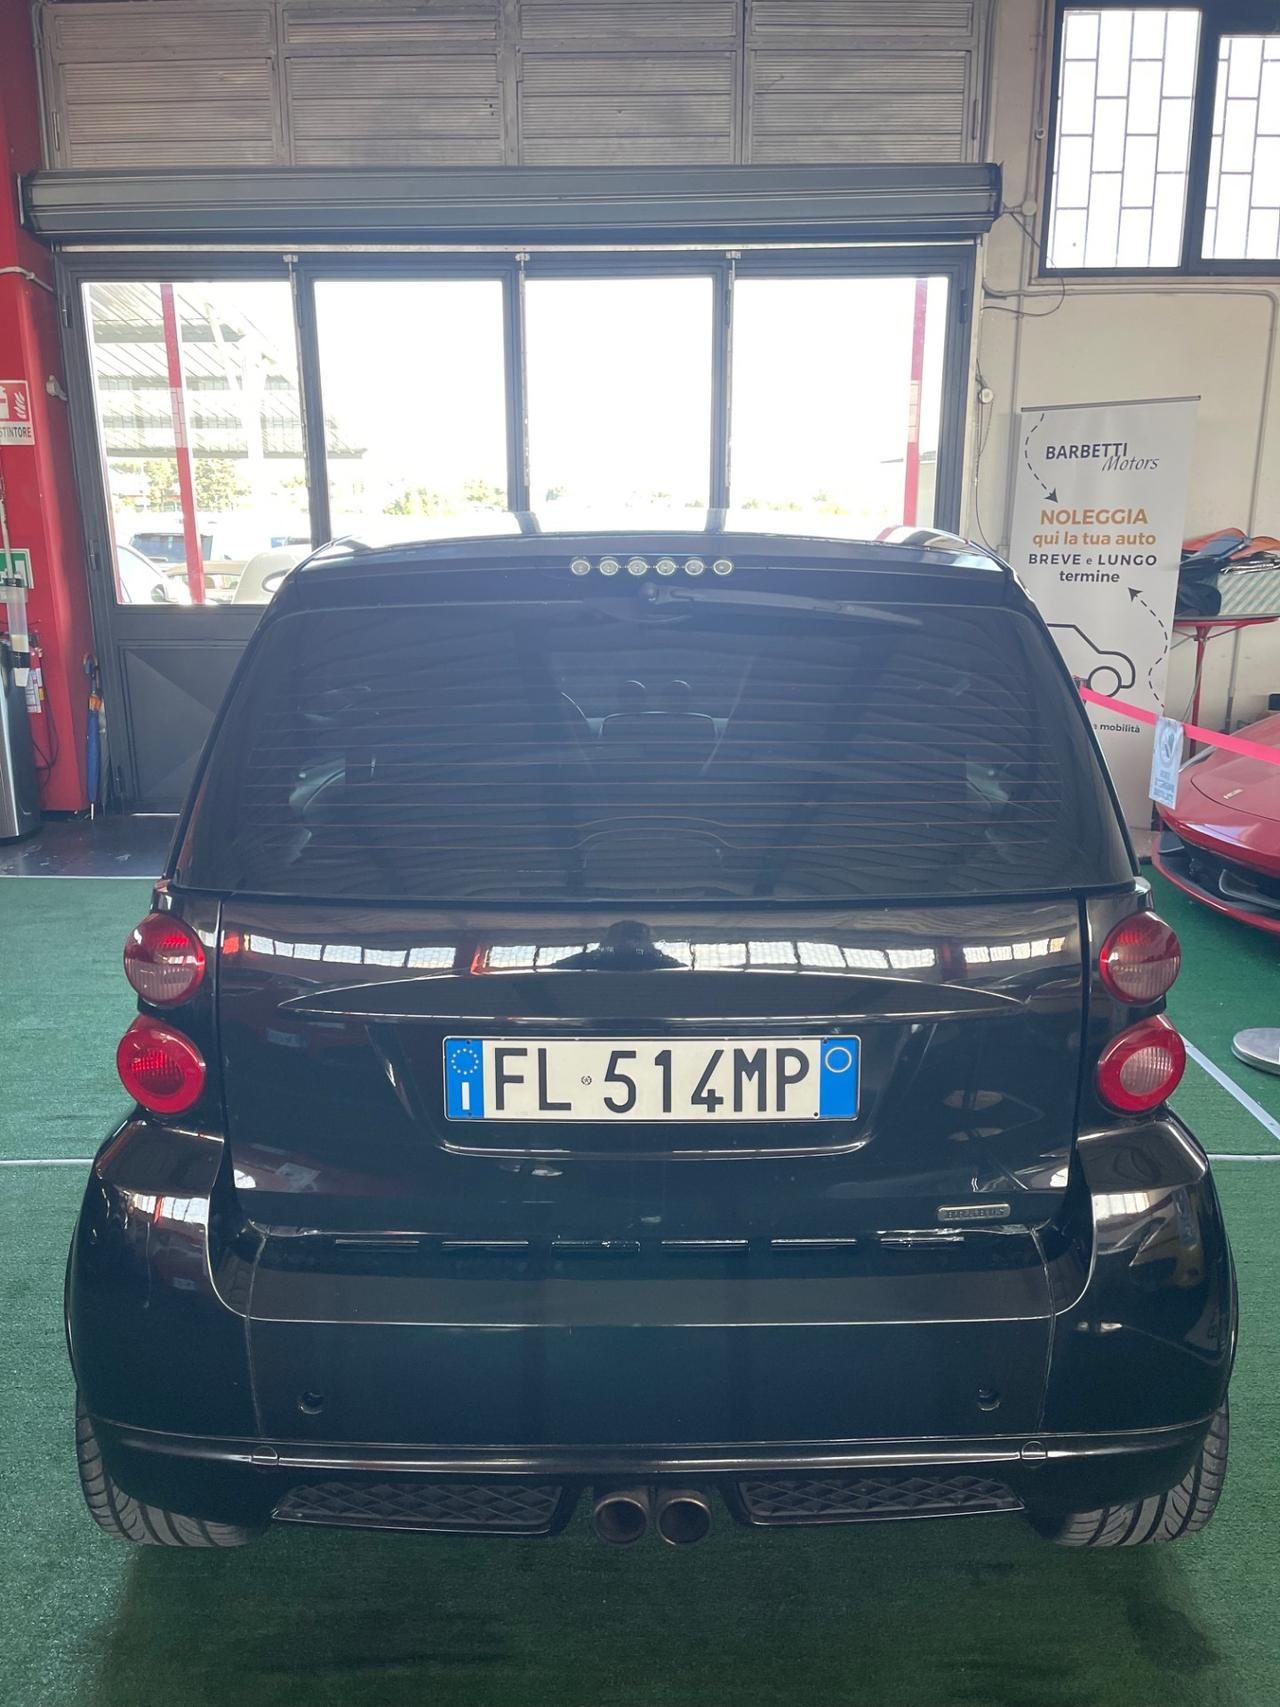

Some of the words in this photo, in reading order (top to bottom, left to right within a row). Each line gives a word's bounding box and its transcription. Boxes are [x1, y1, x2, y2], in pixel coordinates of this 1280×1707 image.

[1045, 442, 1128, 460] BARBETTI
[1101, 455, 1160, 472] Motors
[1040, 508, 1148, 525] NOLEGGIA
[1032, 530, 1059, 548] qui
[1063, 531, 1079, 545] la
[1083, 532, 1111, 545] tua
[1115, 532, 1157, 546] auto
[1028, 553, 1082, 565] BREVE
[1085, 557, 1093, 566] e
[1097, 554, 1158, 567] LUNGO
[1059, 569, 1121, 583] termine
[1100, 723, 1141, 733] mobilità
[494, 1047, 572, 1111] FL
[603, 1047, 811, 1114] 514MP
